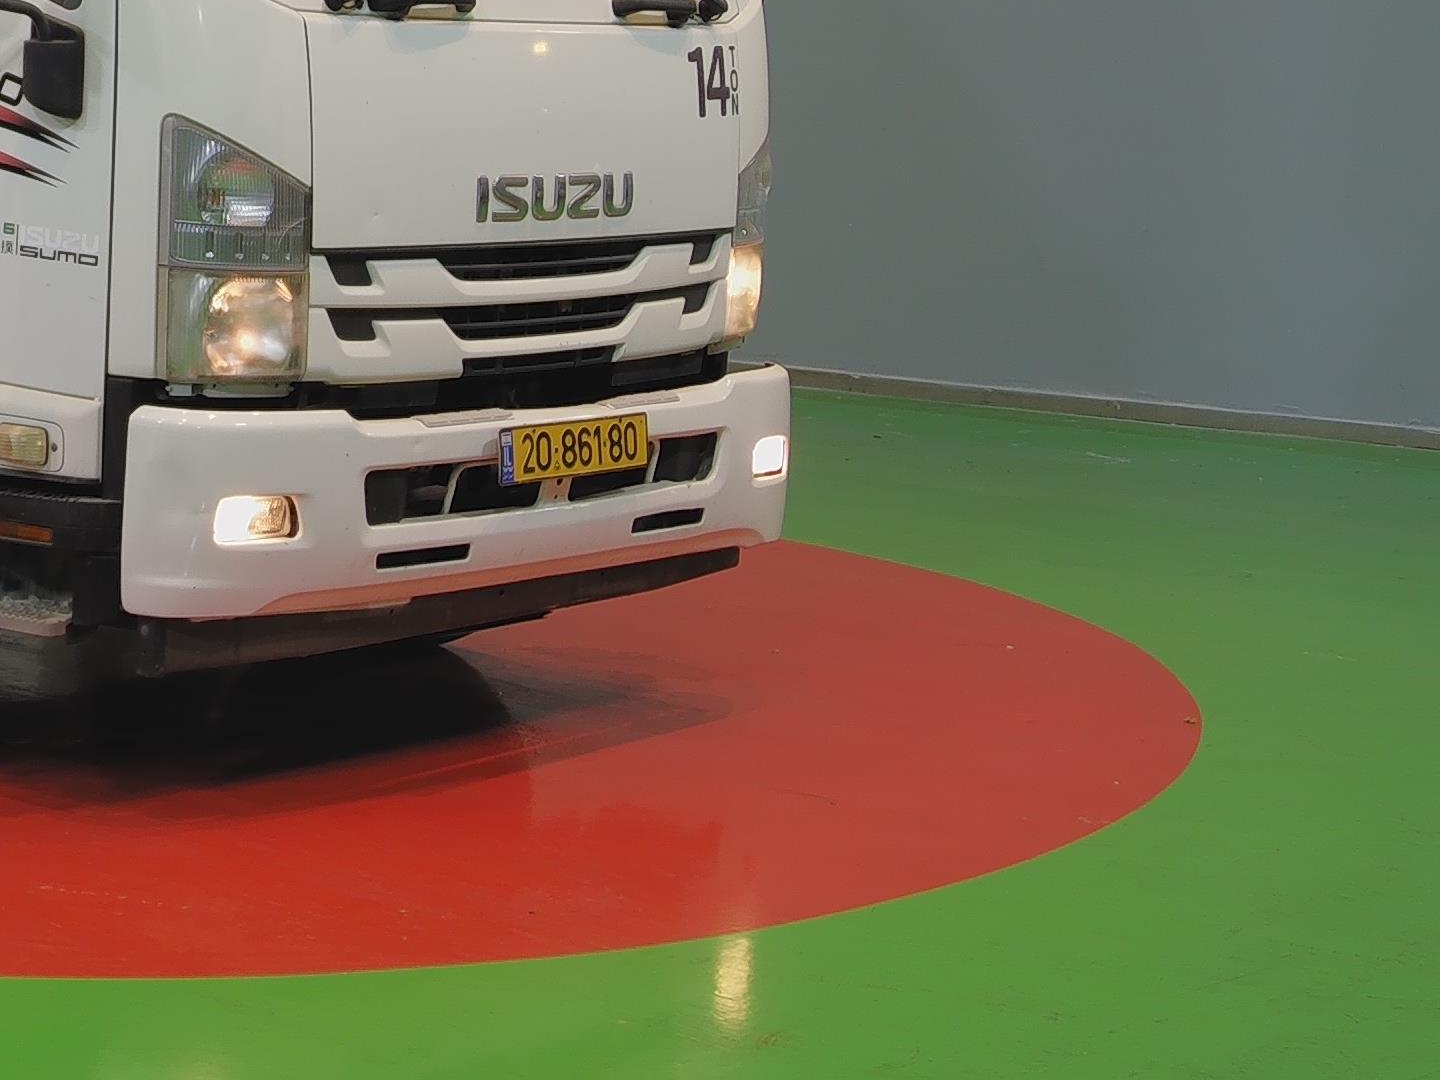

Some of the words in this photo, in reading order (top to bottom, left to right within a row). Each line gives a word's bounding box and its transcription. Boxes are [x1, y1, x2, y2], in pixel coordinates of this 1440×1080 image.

[687, 46, 730, 118] 14
[728, 45, 739, 116] TON
[475, 171, 634, 223] ISUZU
[3, 222, 15, 235] 6
[20, 224, 100, 254] ISUZU
[19, 244, 99, 267] SUMO
